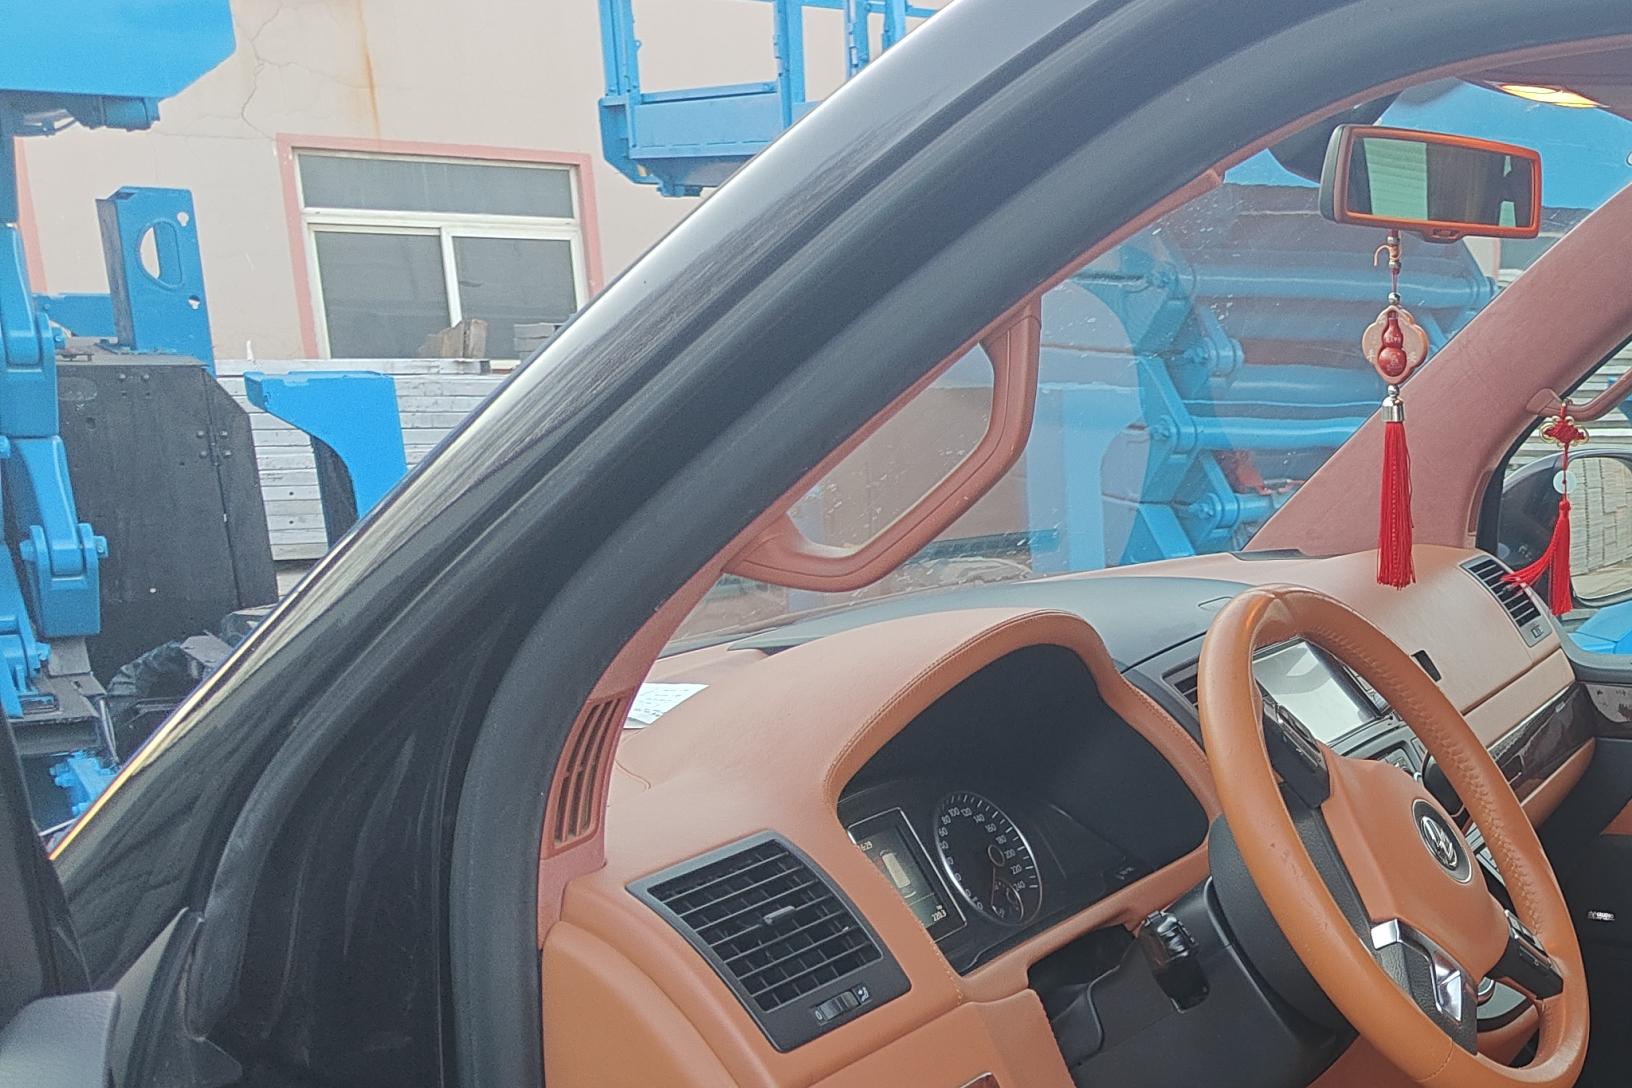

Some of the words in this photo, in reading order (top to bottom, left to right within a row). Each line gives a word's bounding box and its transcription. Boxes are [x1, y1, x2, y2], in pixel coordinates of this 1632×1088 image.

[948, 807, 960, 817] 100
[961, 807, 973, 817] 120
[941, 814, 951, 825] 80
[973, 813, 986, 823] 140
[938, 826, 948, 837] 60
[985, 823, 997, 833] 160
[995, 834, 1007, 844] 180
[1003, 848, 1016, 859] 200
[1010, 863, 1022, 875] 220
[1013, 880, 1026, 891] 240
